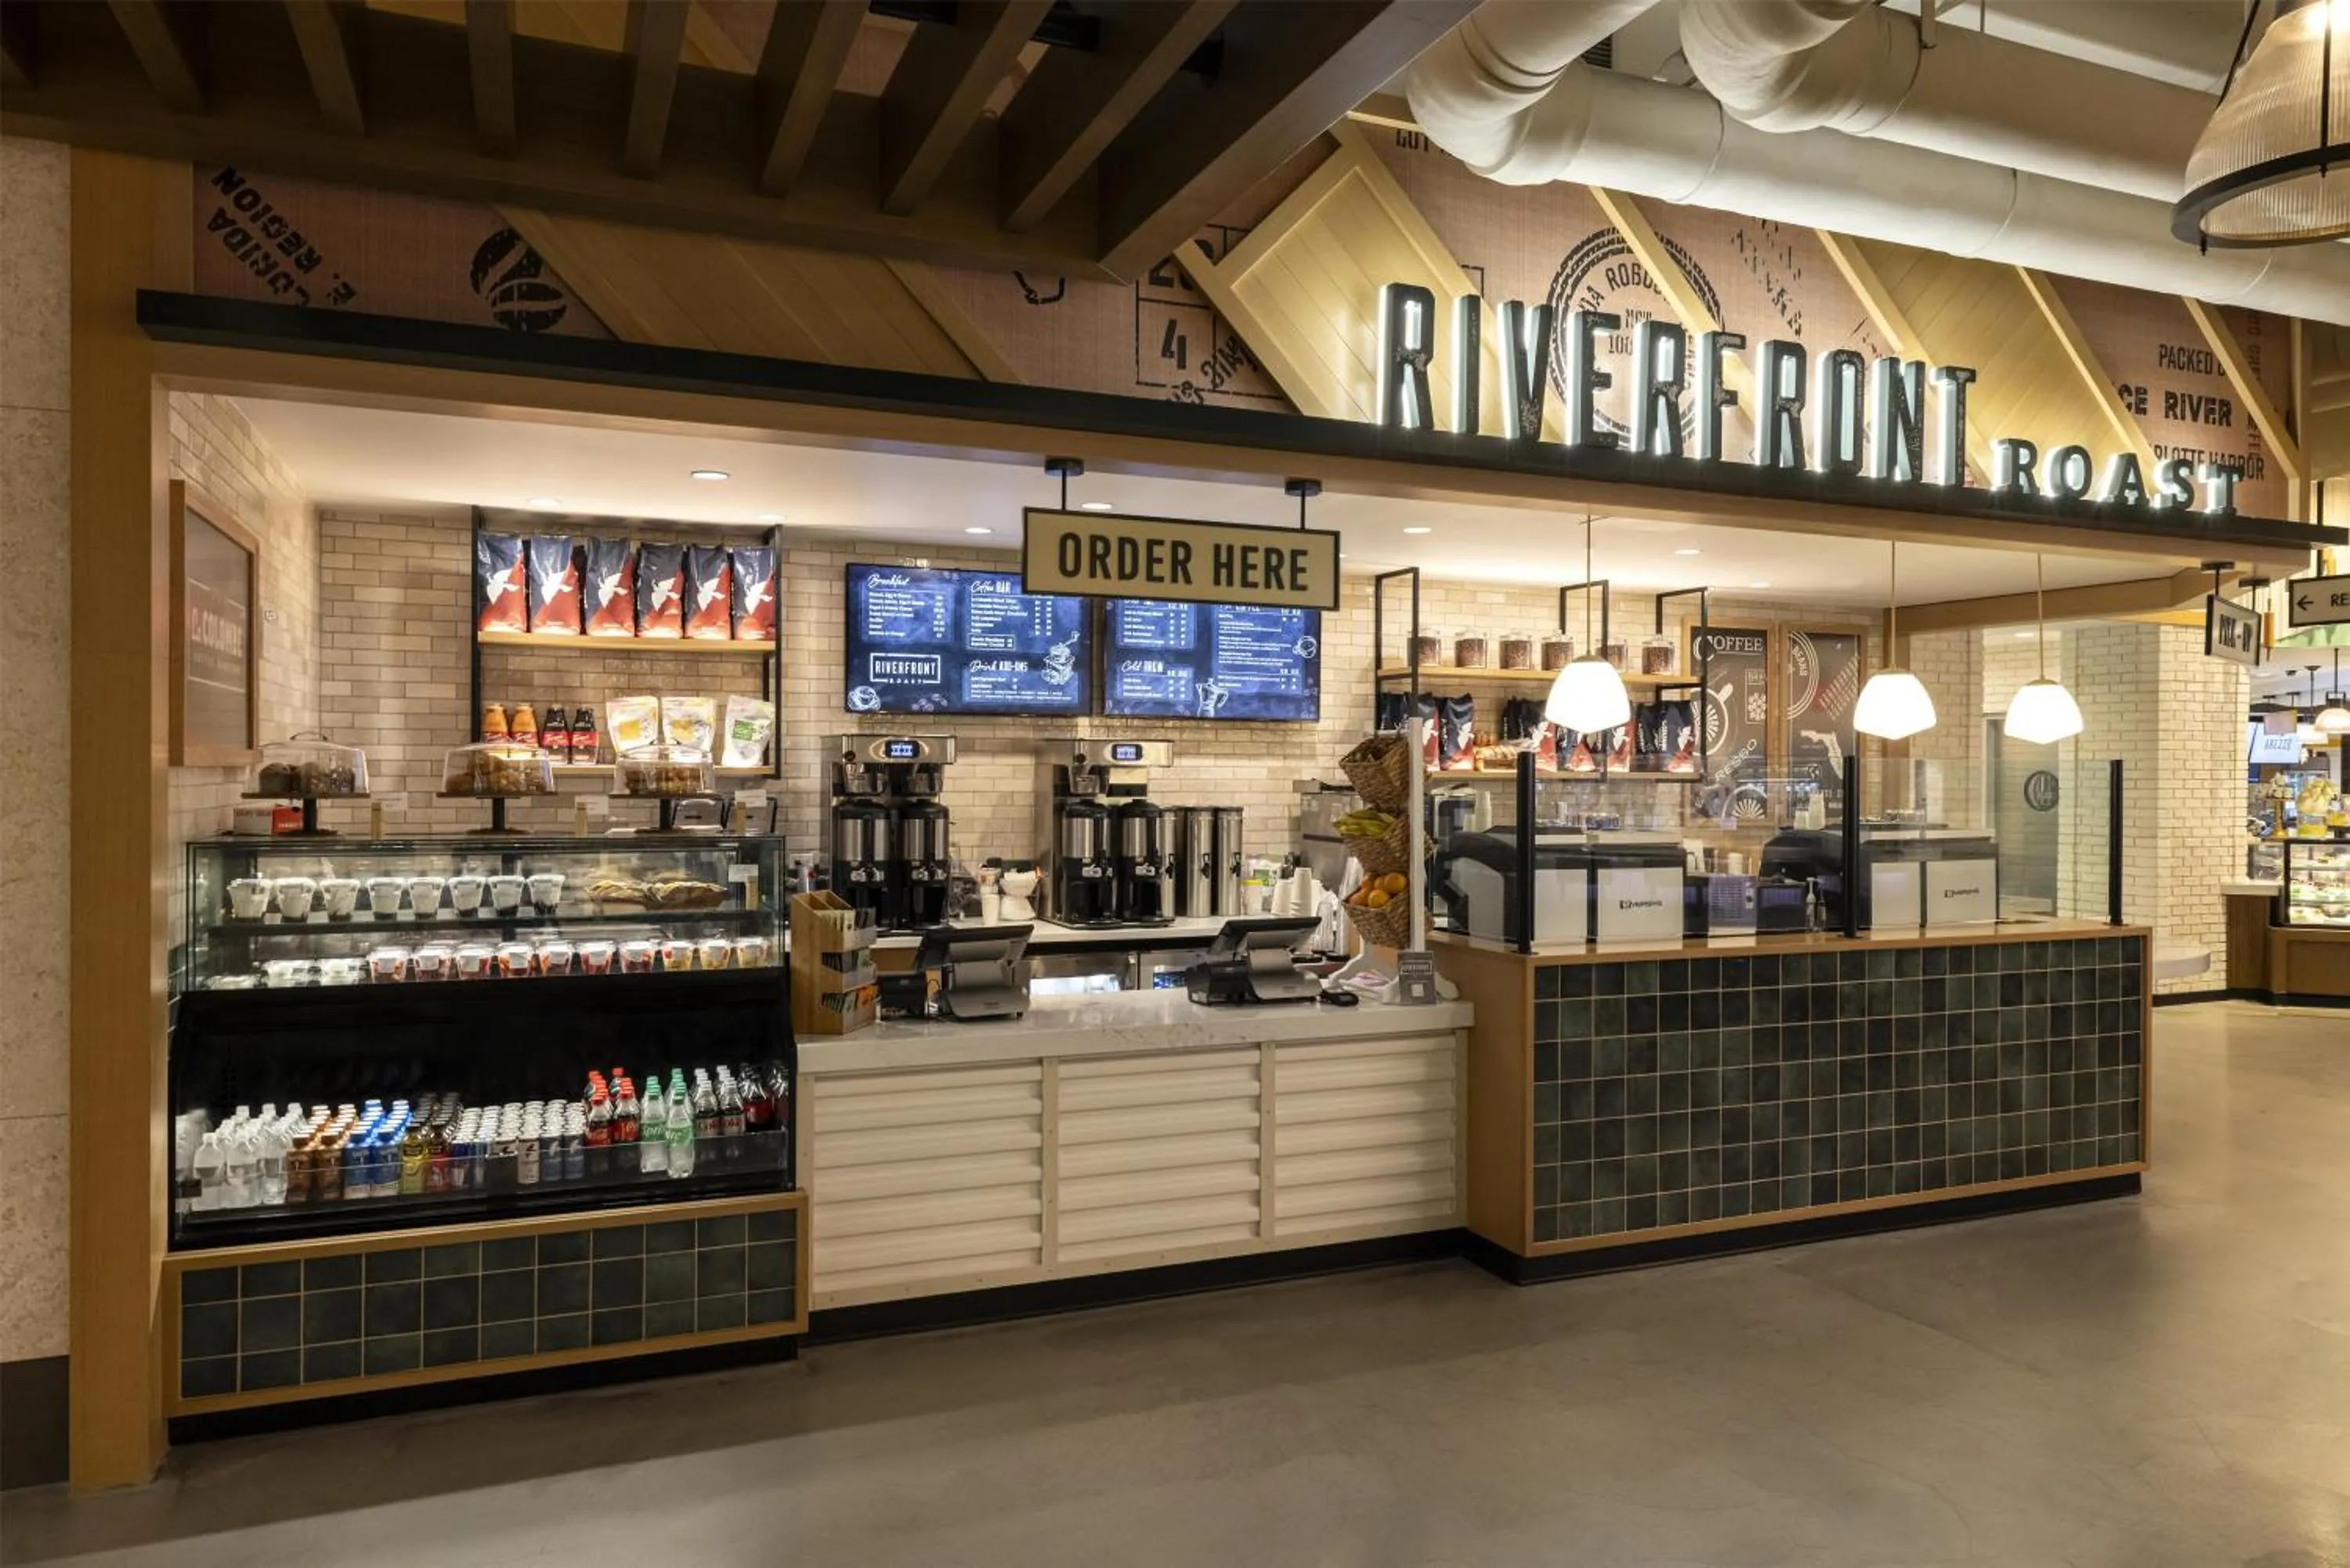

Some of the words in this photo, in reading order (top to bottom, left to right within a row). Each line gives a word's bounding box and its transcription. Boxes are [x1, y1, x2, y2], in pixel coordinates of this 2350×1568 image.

[2159, 343, 2213, 375] PACKED
[1377, 283, 1976, 486] RIVERFRONT
[2114, 381, 2149, 417] CE
[2164, 390, 2232, 427] RIVER
[1992, 438, 2243, 515] ROAST
[1058, 532, 1193, 586] ORDER
[1213, 543, 1309, 591] HERE
[875, 660, 936, 675] RIVERFRONT
[1693, 635, 1764, 662] COFFEE
